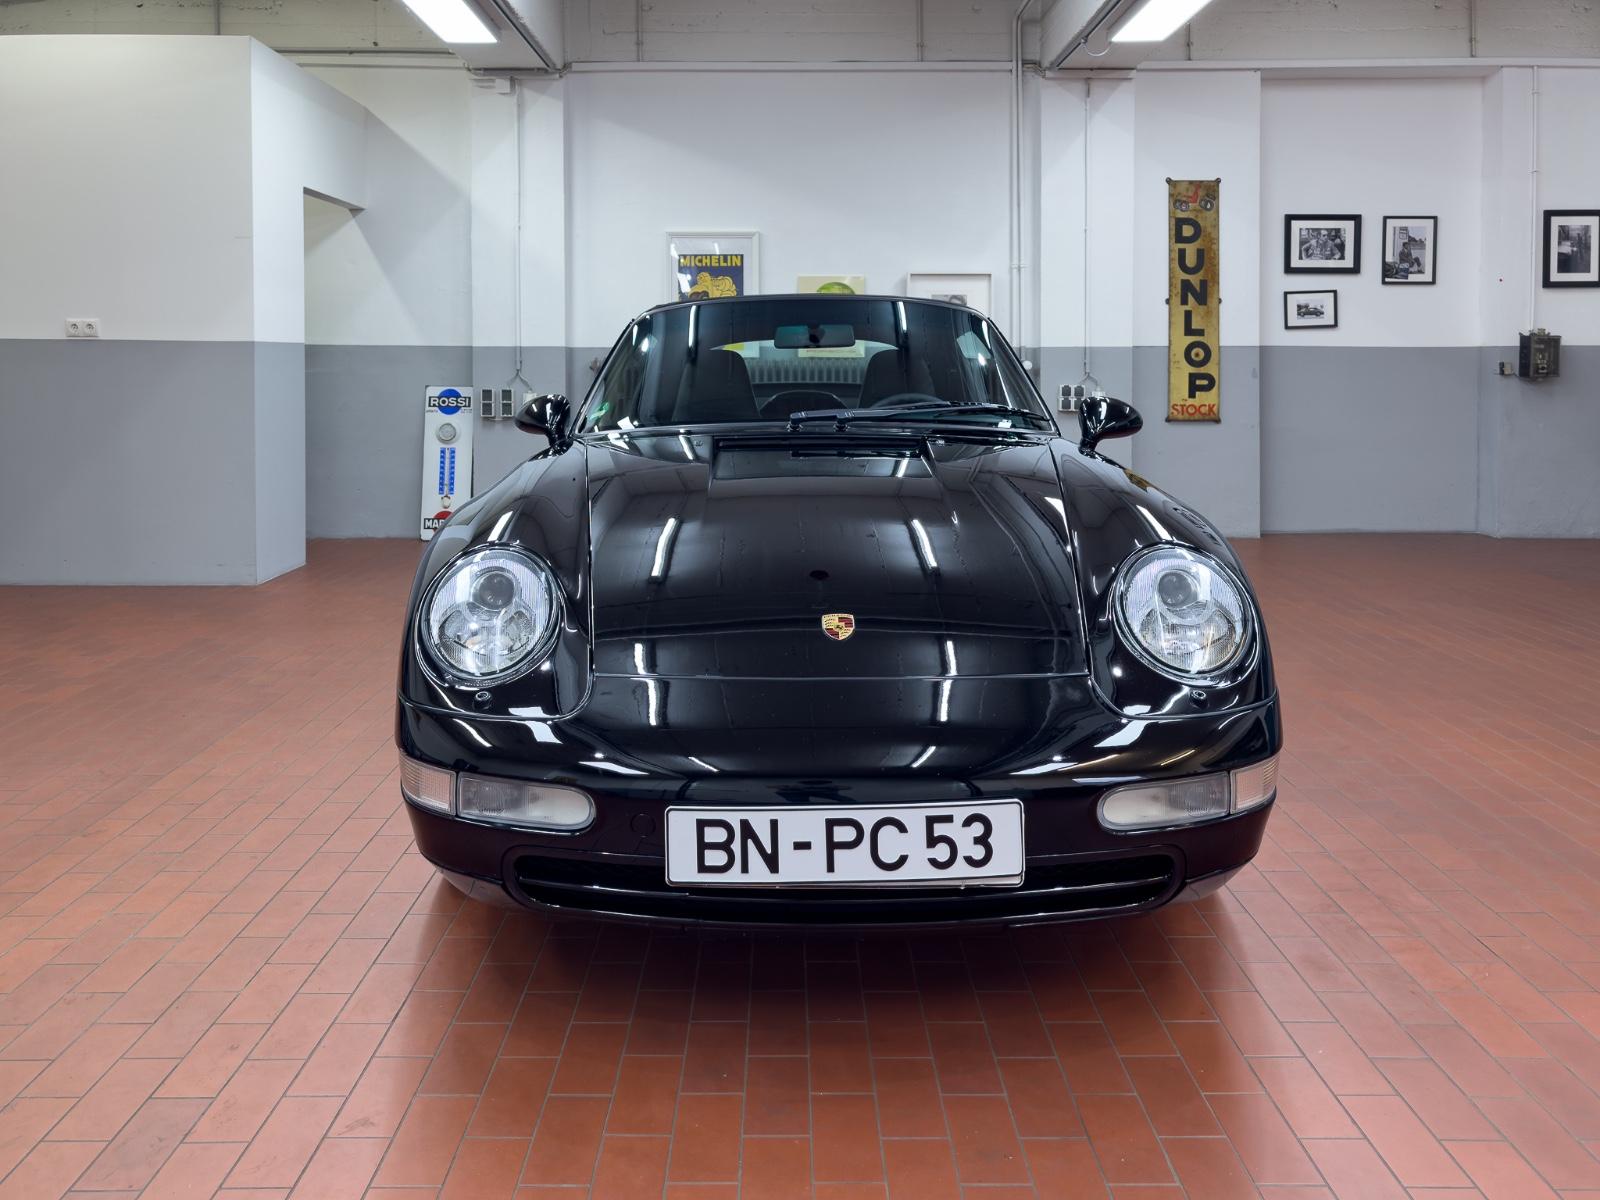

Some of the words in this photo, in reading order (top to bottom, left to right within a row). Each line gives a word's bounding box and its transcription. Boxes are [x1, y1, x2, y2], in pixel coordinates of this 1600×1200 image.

[680, 255, 741, 267] MICHELIN
[1175, 217, 1216, 399] DUNLOP
[430, 397, 470, 407] ROSSI
[1171, 403, 1217, 417] STOCK
[924, 812, 994, 870] 53
